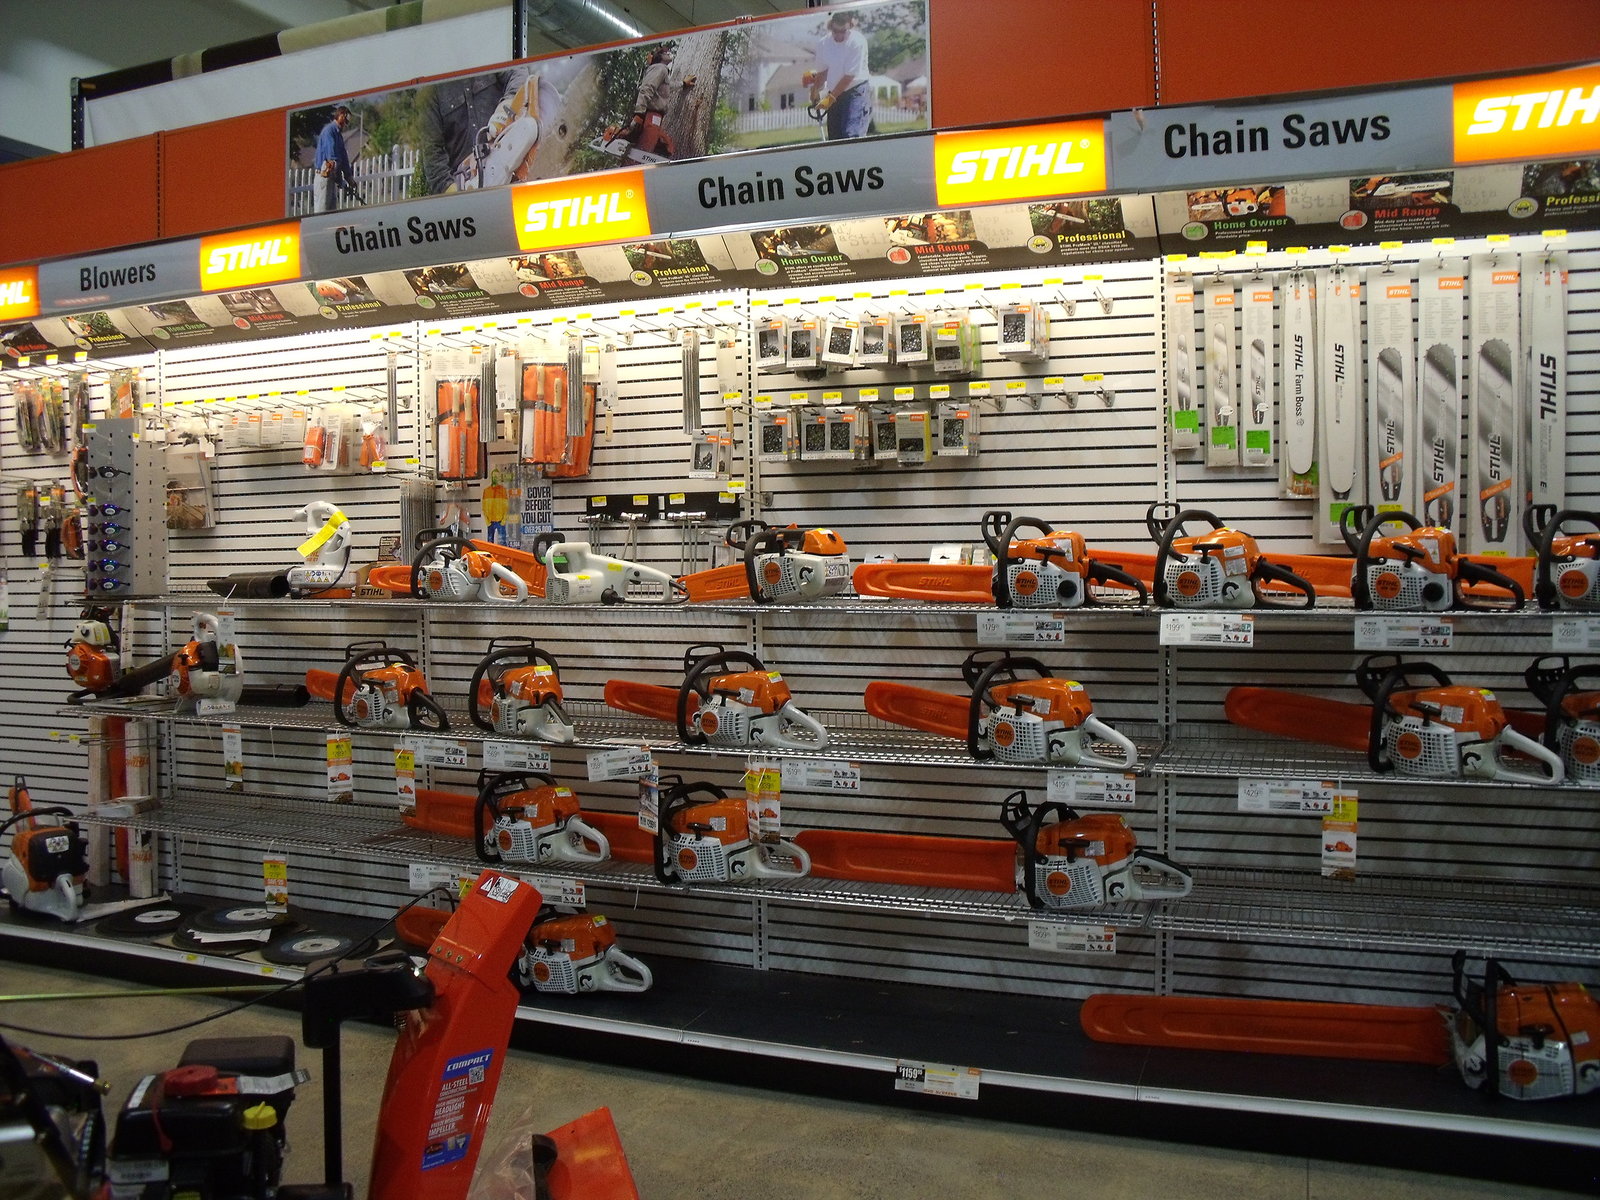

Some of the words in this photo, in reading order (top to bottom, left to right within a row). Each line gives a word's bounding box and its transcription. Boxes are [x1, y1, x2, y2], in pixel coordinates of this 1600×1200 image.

[1164, 119, 1269, 160] Chain
[1282, 113, 1391, 149] Saws
[947, 141, 1085, 185] STIHL
[698, 172, 785, 209] Chain
[795, 165, 884, 198] Saws
[524, 192, 631, 232] STIHL
[1374, 208, 1398, 219] Mid
[1401, 206, 1441, 218] Range
[1214, 220, 1246, 230] Home
[1250, 217, 1288, 228] Owner
[335, 221, 401, 254] Chain
[408, 215, 477, 245] Saws
[1057, 230, 1126, 244] Professional
[914, 245, 936, 255] Mid
[937, 242, 970, 253] Range
[207, 241, 289, 275] STIHL
[780, 256, 809, 267] Home
[811, 254, 843, 264] Owner
[80, 263, 156, 291] Blowers
[652, 264, 710, 277] Professional
[539, 280, 556, 289] Mid
[557, 277, 585, 288] Range
[434, 292, 456, 302] Home
[458, 289, 485, 299] Owner
[1389, 288, 1410, 296] STIHL
[336, 300, 381, 312] Professional
[1294, 334, 1304, 371] STIHL
[1335, 343, 1345, 383] STIHL
[1295, 374, 1304, 395] Farm
[1540, 353, 1557, 420] STIHL
[1296, 397, 1305, 417] Boss
[1387, 420, 1395, 455] STIHL
[1433, 438, 1445, 483] STIHL
[1490, 435, 1501, 481] STIHL
[527, 486, 551, 498] COVER
[525, 499, 551, 511] BEFORE
[521, 512, 535, 524] YOU
[537, 512, 551, 523] CUT
[919, 576, 950, 587] STIHL
[446, 1054, 491, 1072] COMPACT
[442, 1078, 469, 1091] ALL-STEEL
[434, 1101, 466, 1116] HEADLIGHT
[429, 1122, 456, 1136] IMPELLER
